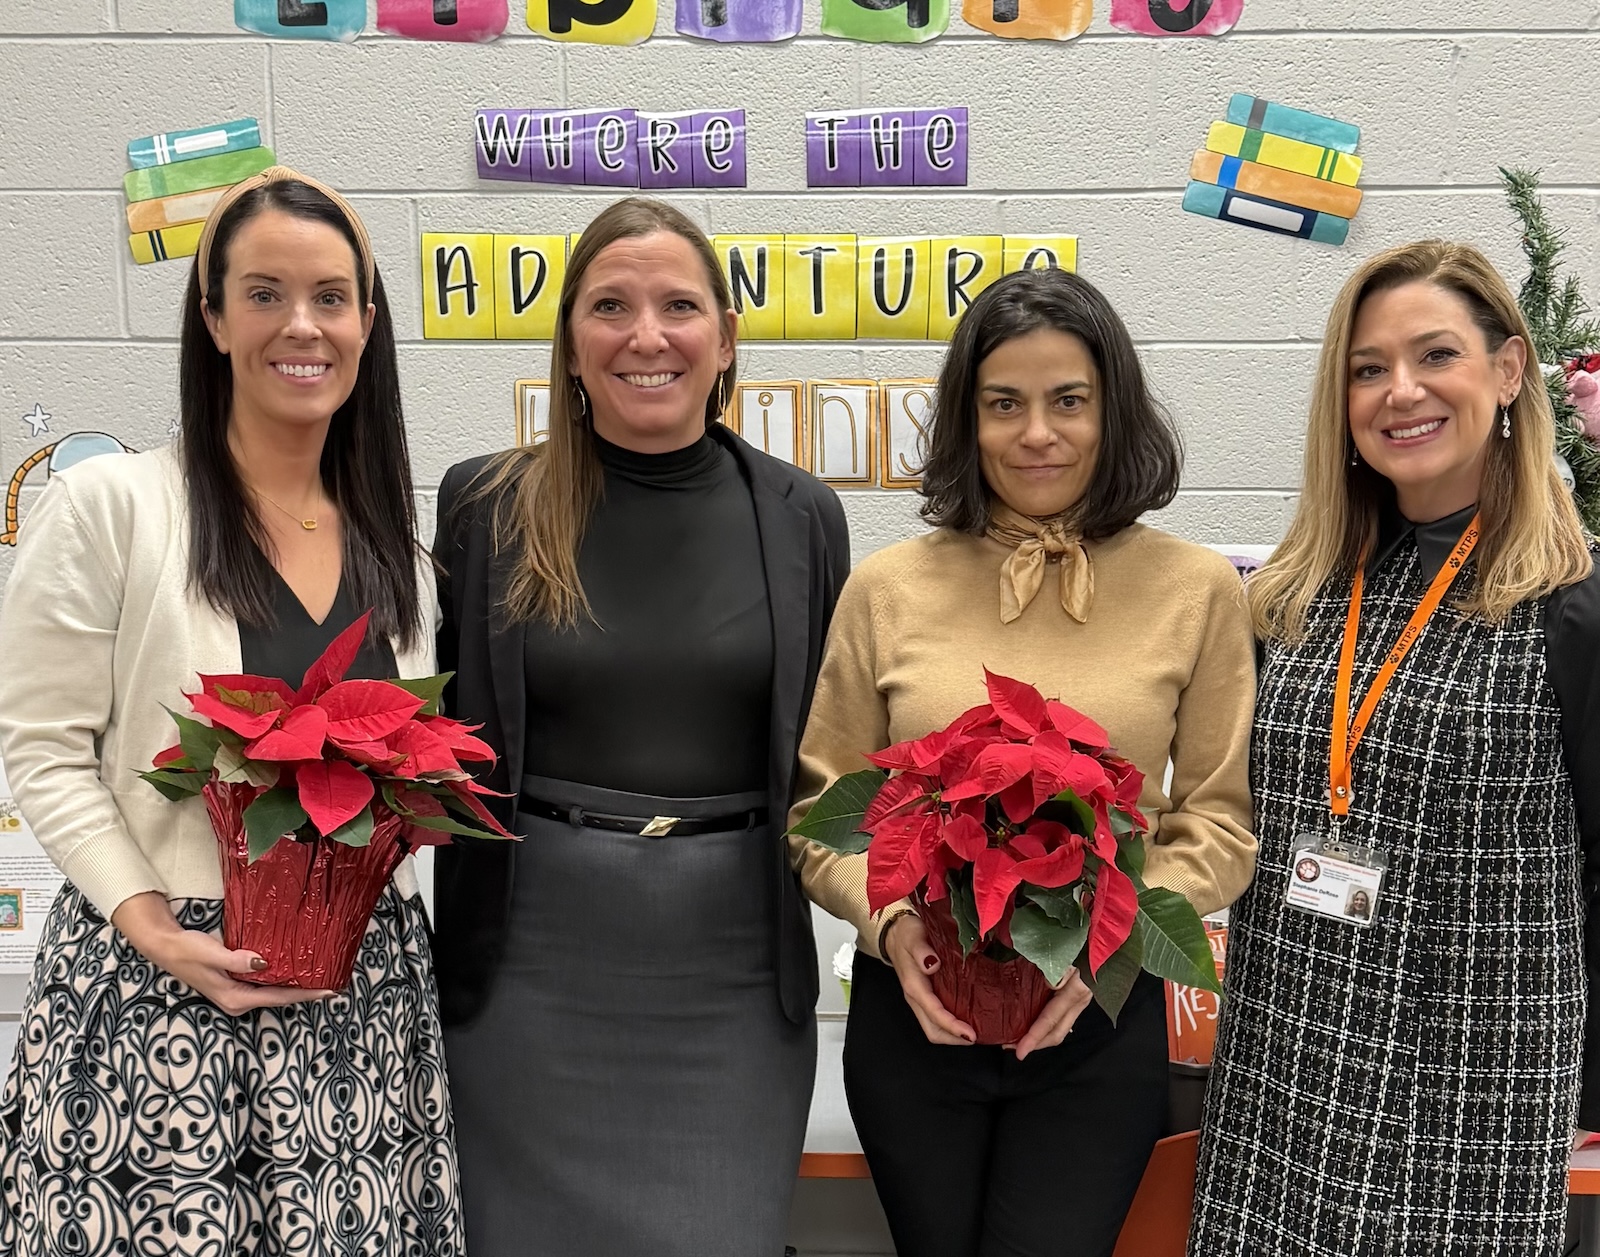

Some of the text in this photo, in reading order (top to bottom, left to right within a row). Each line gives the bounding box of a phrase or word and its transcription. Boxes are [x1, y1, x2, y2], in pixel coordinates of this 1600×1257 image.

[435, 245, 1058, 317] ADNTUR
[1456, 529, 1478, 557] MTPS
[1397, 625, 1417, 652] MTPS
[1292, 881, 1318, 894] Stephanie
